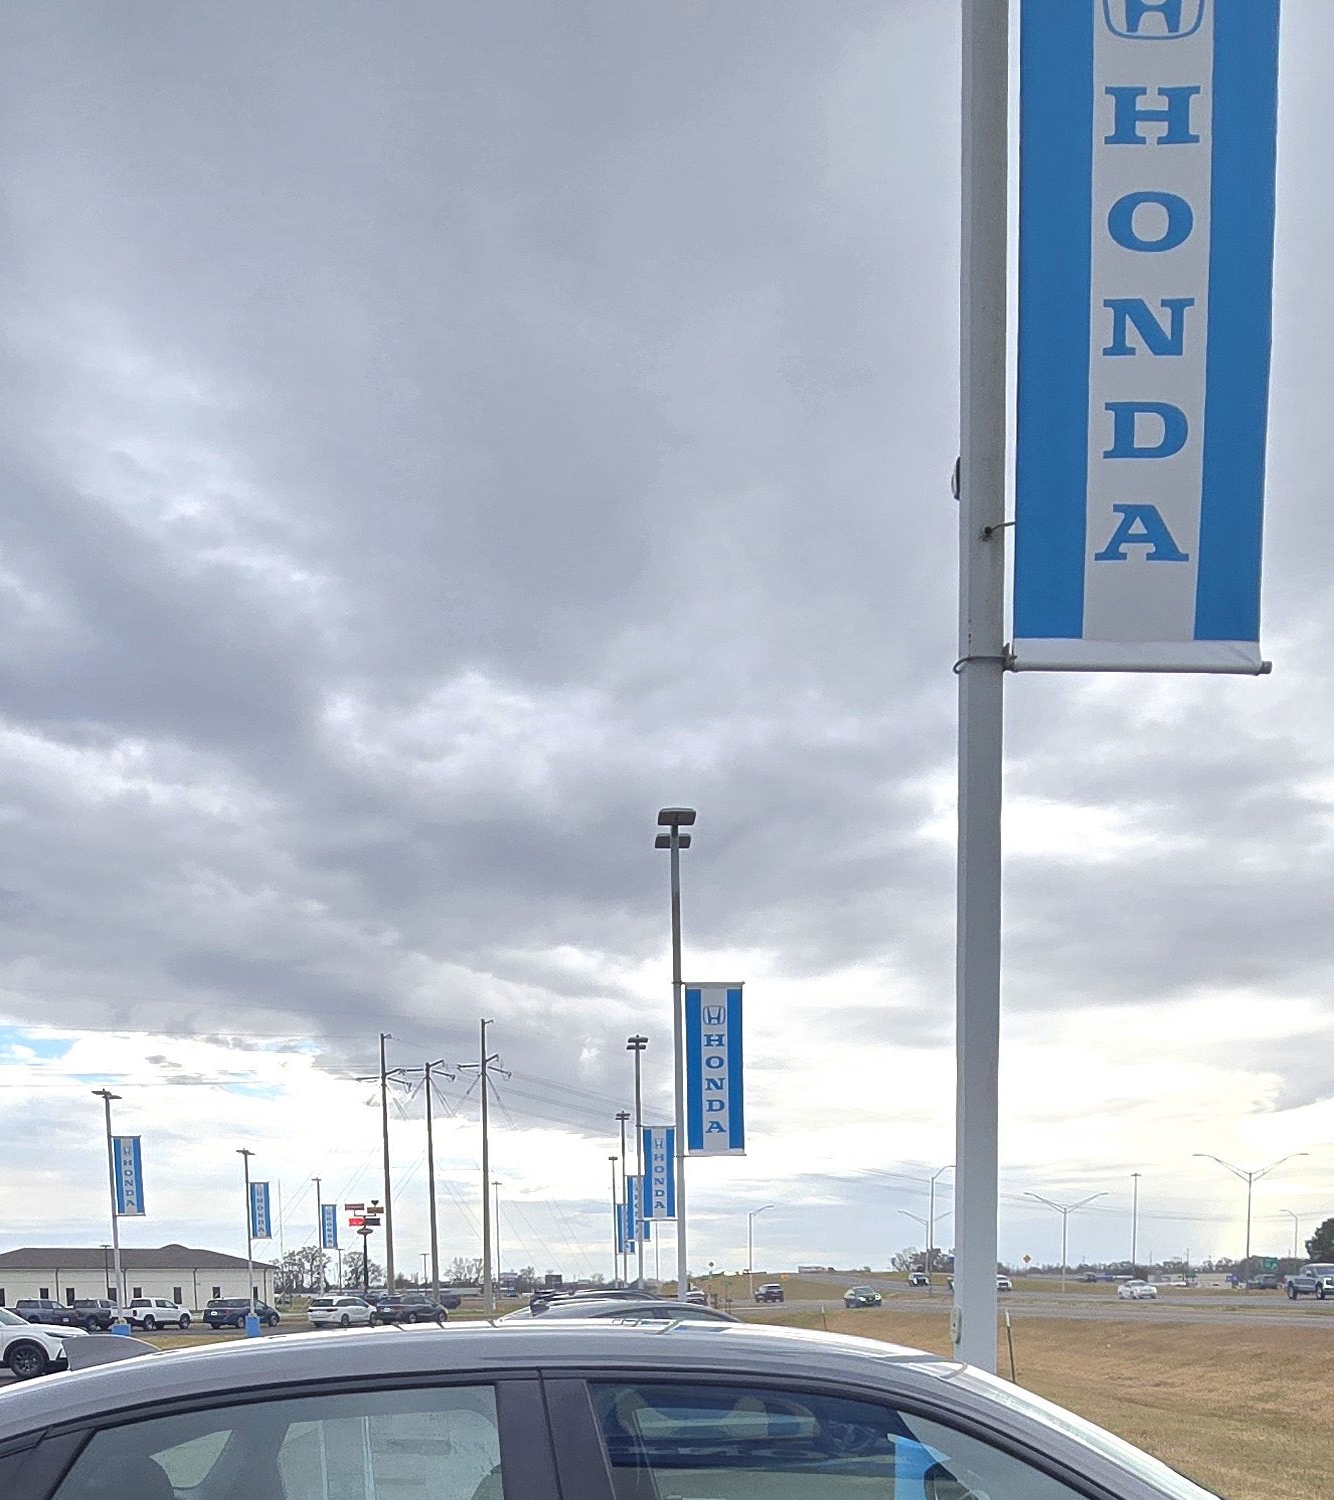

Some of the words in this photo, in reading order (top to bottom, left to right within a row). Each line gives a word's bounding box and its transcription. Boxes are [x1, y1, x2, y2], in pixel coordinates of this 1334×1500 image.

[1094, 85, 1201, 562] HONDA
[704, 1034, 726, 1133] HONDA
[123, 1160, 135, 1207] HONDA
[654, 1153, 665, 1209] HONDA
[257, 1198, 265, 1232] HONDA
